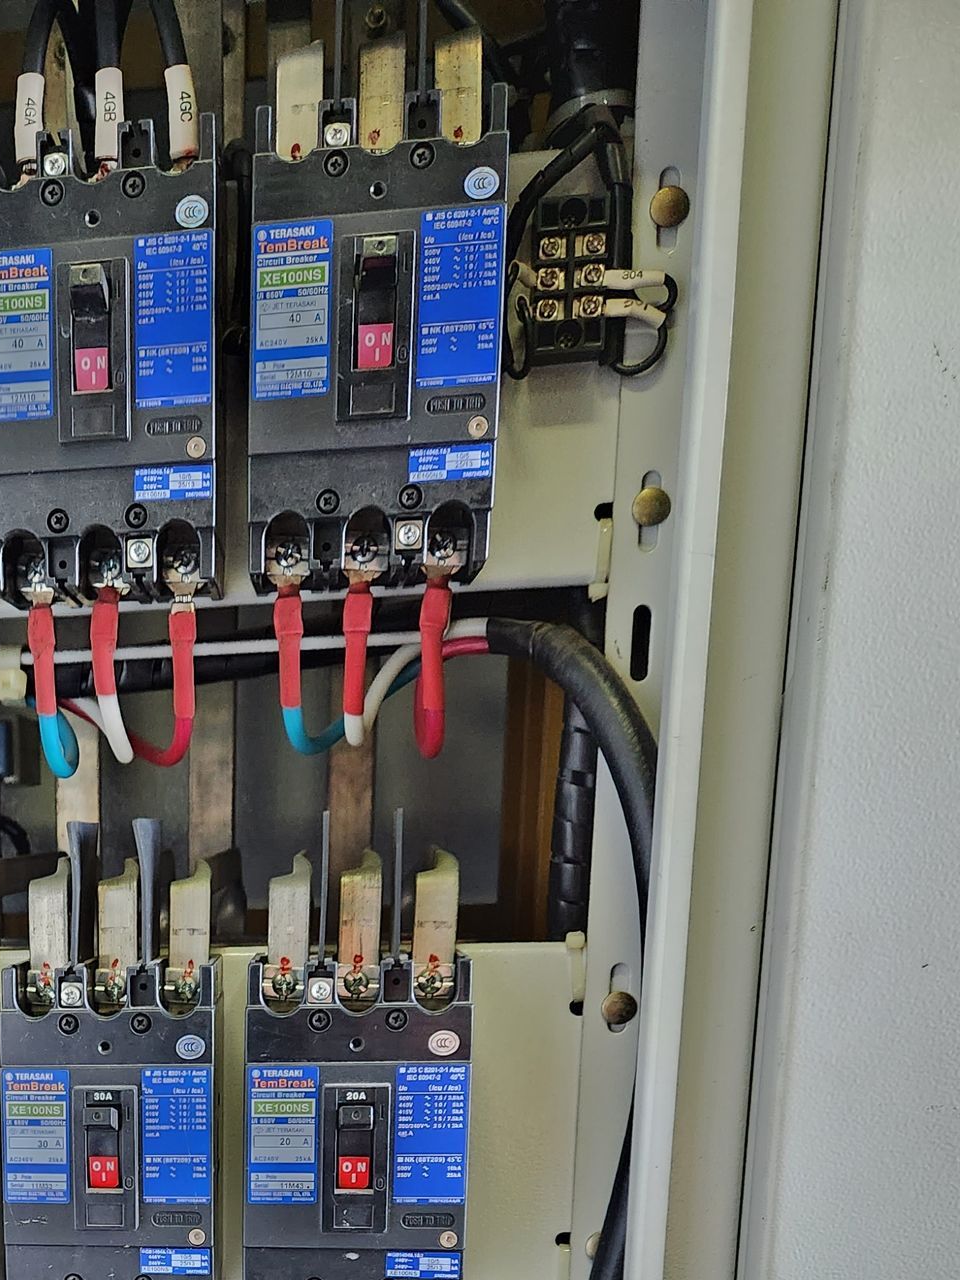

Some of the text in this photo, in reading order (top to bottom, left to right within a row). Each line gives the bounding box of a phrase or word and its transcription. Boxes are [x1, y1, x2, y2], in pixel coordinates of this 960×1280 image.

[25, 98, 36, 126] 4GA
[104, 92, 116, 122] 4GB
[179, 91, 192, 123] 4GC
[270, 226, 314, 239] TERASAKI
[259, 237, 328, 253] TemBreak
[257, 255, 317, 267] Circuit Breaker
[263, 269, 321, 285] XE100NS
[8, 282, 38, 291] Breaker
[289, 313, 321, 323] 40 A
[6, 1082, 64, 1091] TemBreak
[253, 1079, 314, 1088] TemBreak
[346, 1092, 366, 1100] 20A
[12, 1106, 60, 1115] XE100NS
[258, 1104, 309, 1112] XE100NS
